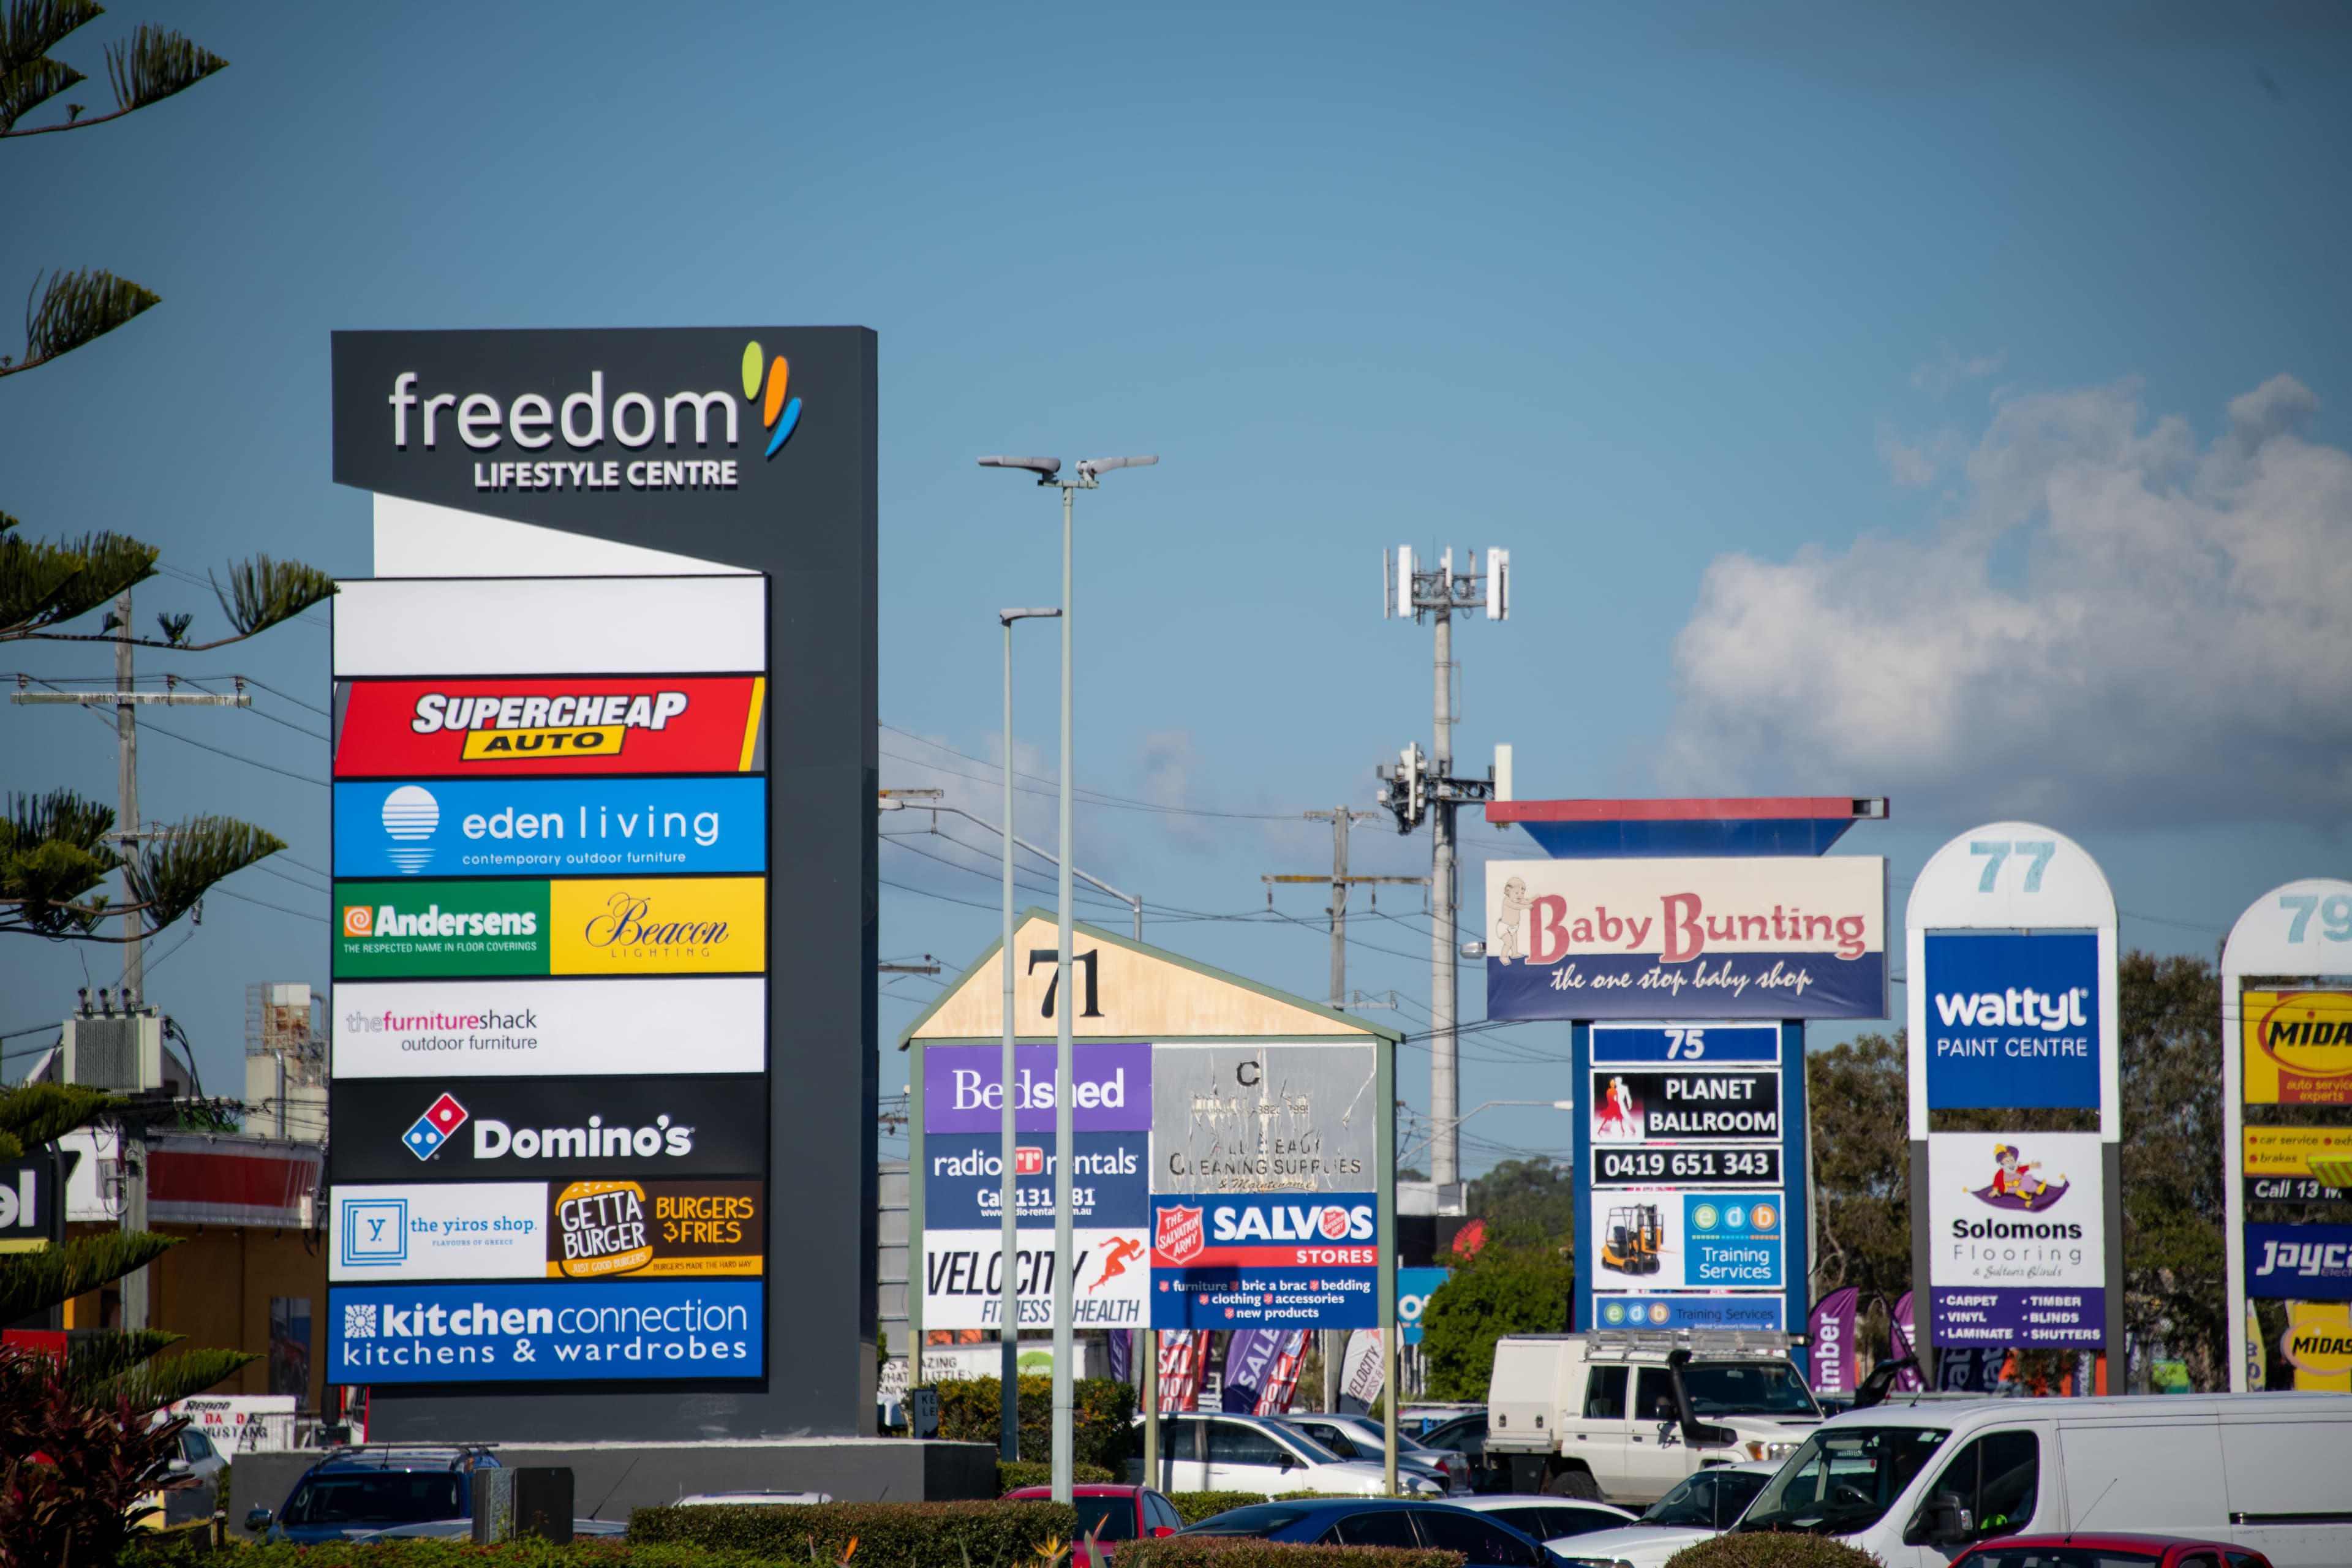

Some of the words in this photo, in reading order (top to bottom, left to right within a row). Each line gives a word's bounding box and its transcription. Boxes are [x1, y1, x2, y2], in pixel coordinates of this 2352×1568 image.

[388, 371, 737, 448] freedom
[474, 462, 620, 488] LIFESTYLE
[627, 460, 738, 486] CENTRE
[412, 692, 687, 733] SUPERCHEAP
[483, 732, 604, 752] AUTO
[463, 807, 564, 839] eden
[580, 806, 718, 846] living
[462, 854, 561, 866] contemporary
[567, 853, 622, 864] outdoor
[627, 851, 686, 862] furniture
[1970, 840, 2056, 894] 77
[374, 905, 537, 937] Andersens
[585, 892, 729, 948] Beacon
[1525, 894, 1653, 965] Baby
[1659, 892, 1866, 963] Bunting
[2279, 895, 2352, 943] 79
[344, 943, 360, 953] THE
[363, 943, 413, 953] RESPECTED
[415, 943, 442, 952] NAME
[445, 943, 454, 952] IN
[457, 942, 484, 952] FLOOR
[486, 941, 537, 951] COVERINGS
[611, 948, 710, 957] LIGHTING
[1028, 949, 1104, 1019] 71
[1550, 963, 1586, 990] the
[1590, 973, 1633, 989] one
[1637, 965, 1688, 996] stop
[1692, 961, 1750, 998] baby
[1755, 961, 1814, 996] shop
[1935, 987, 2087, 1031] wattyl
[402, 1036, 464, 1051] outdoor
[469, 1035, 537, 1050] furniture
[1664, 1029, 1705, 1059] 75
[1937, 1038, 1999, 1057] PAINT
[2005, 1037, 2088, 1057] CENTRE
[1666, 1079, 1756, 1100] PLANET
[2300, 1091, 2344, 1103] experts
[1649, 1112, 1776, 1131] BALLROOM
[474, 1115, 692, 1159] Domino's
[2280, 1136, 2318, 1145] service
[934, 1148, 1002, 1176] radio
[1046, 1147, 1137, 1175] rntals
[1605, 1155, 1665, 1177] 0419
[1672, 1154, 1717, 1175] 651
[1724, 1153, 1769, 1175] 343
[2260, 1153, 2297, 1163] brakes
[1072, 1188, 1096, 1206] 81
[2255, 1179, 2291, 1198] Call
[2297, 1180, 2320, 1198] 13
[560, 1189, 643, 1232] GETTA
[656, 1196, 754, 1219] BURGERS
[410, 1218, 438, 1232] the
[443, 1217, 488, 1236] yiros
[1159, 1213, 1199, 1249] SALVATION
[1165, 1211, 1183, 1230] THE
[1213, 1205, 1373, 1240] SALVOS
[1953, 1218, 2082, 1239] Solomons
[563, 1222, 646, 1260] BURGER
[680, 1221, 742, 1243] FRIES
[1173, 1230, 1197, 1256] ARMY
[571, 1262, 590, 1273] JUST
[592, 1261, 612, 1272] GOOD
[614, 1251, 646, 1270] BURGERS
[653, 1262, 684, 1271] BURGERS
[738, 1260, 752, 1268] WAY
[1296, 1250, 1373, 1264] STORES
[1702, 1246, 1770, 1265] Training
[1954, 1244, 2082, 1265] Flooring
[2256, 1240, 2352, 1276] Jayc
[1699, 1263, 1771, 1279] Services
[1173, 1280, 1228, 1292] furniture
[1242, 1280, 1266, 1291] bric
[1280, 1280, 1307, 1291] brac
[1321, 1280, 1371, 1293] bedding
[1073, 1299, 1140, 1322] HEALTH
[1212, 1294, 1261, 1306] clothing
[1275, 1294, 1344, 1304] accessories
[1947, 1295, 1999, 1306] CARPET
[2030, 1296, 2082, 1307] TIMBER
[383, 1303, 552, 1336] kitchen
[559, 1299, 747, 1333] connection
[1237, 1310, 1261, 1318] new
[1265, 1307, 1319, 1321] products
[1676, 1309, 1722, 1322] Training
[1726, 1308, 1774, 1320] Services
[1947, 1311, 1987, 1322] VINYL
[2030, 1313, 2079, 1323] BLINDS
[1947, 1328, 2013, 1339] LAMINATE
[2031, 1329, 2101, 1340] SHUTTERS
[344, 1340, 495, 1366] kitchens
[513, 1338, 535, 1363] &
[554, 1335, 747, 1363] wardrobes
[1815, 1312, 1841, 1393] imber
[2291, 1337, 2352, 1354] MIDAS
[1238, 1329, 1280, 1392] SALE
[1348, 1345, 1380, 1401] VELOCITY
[1159, 1377, 1193, 1397] NOW
